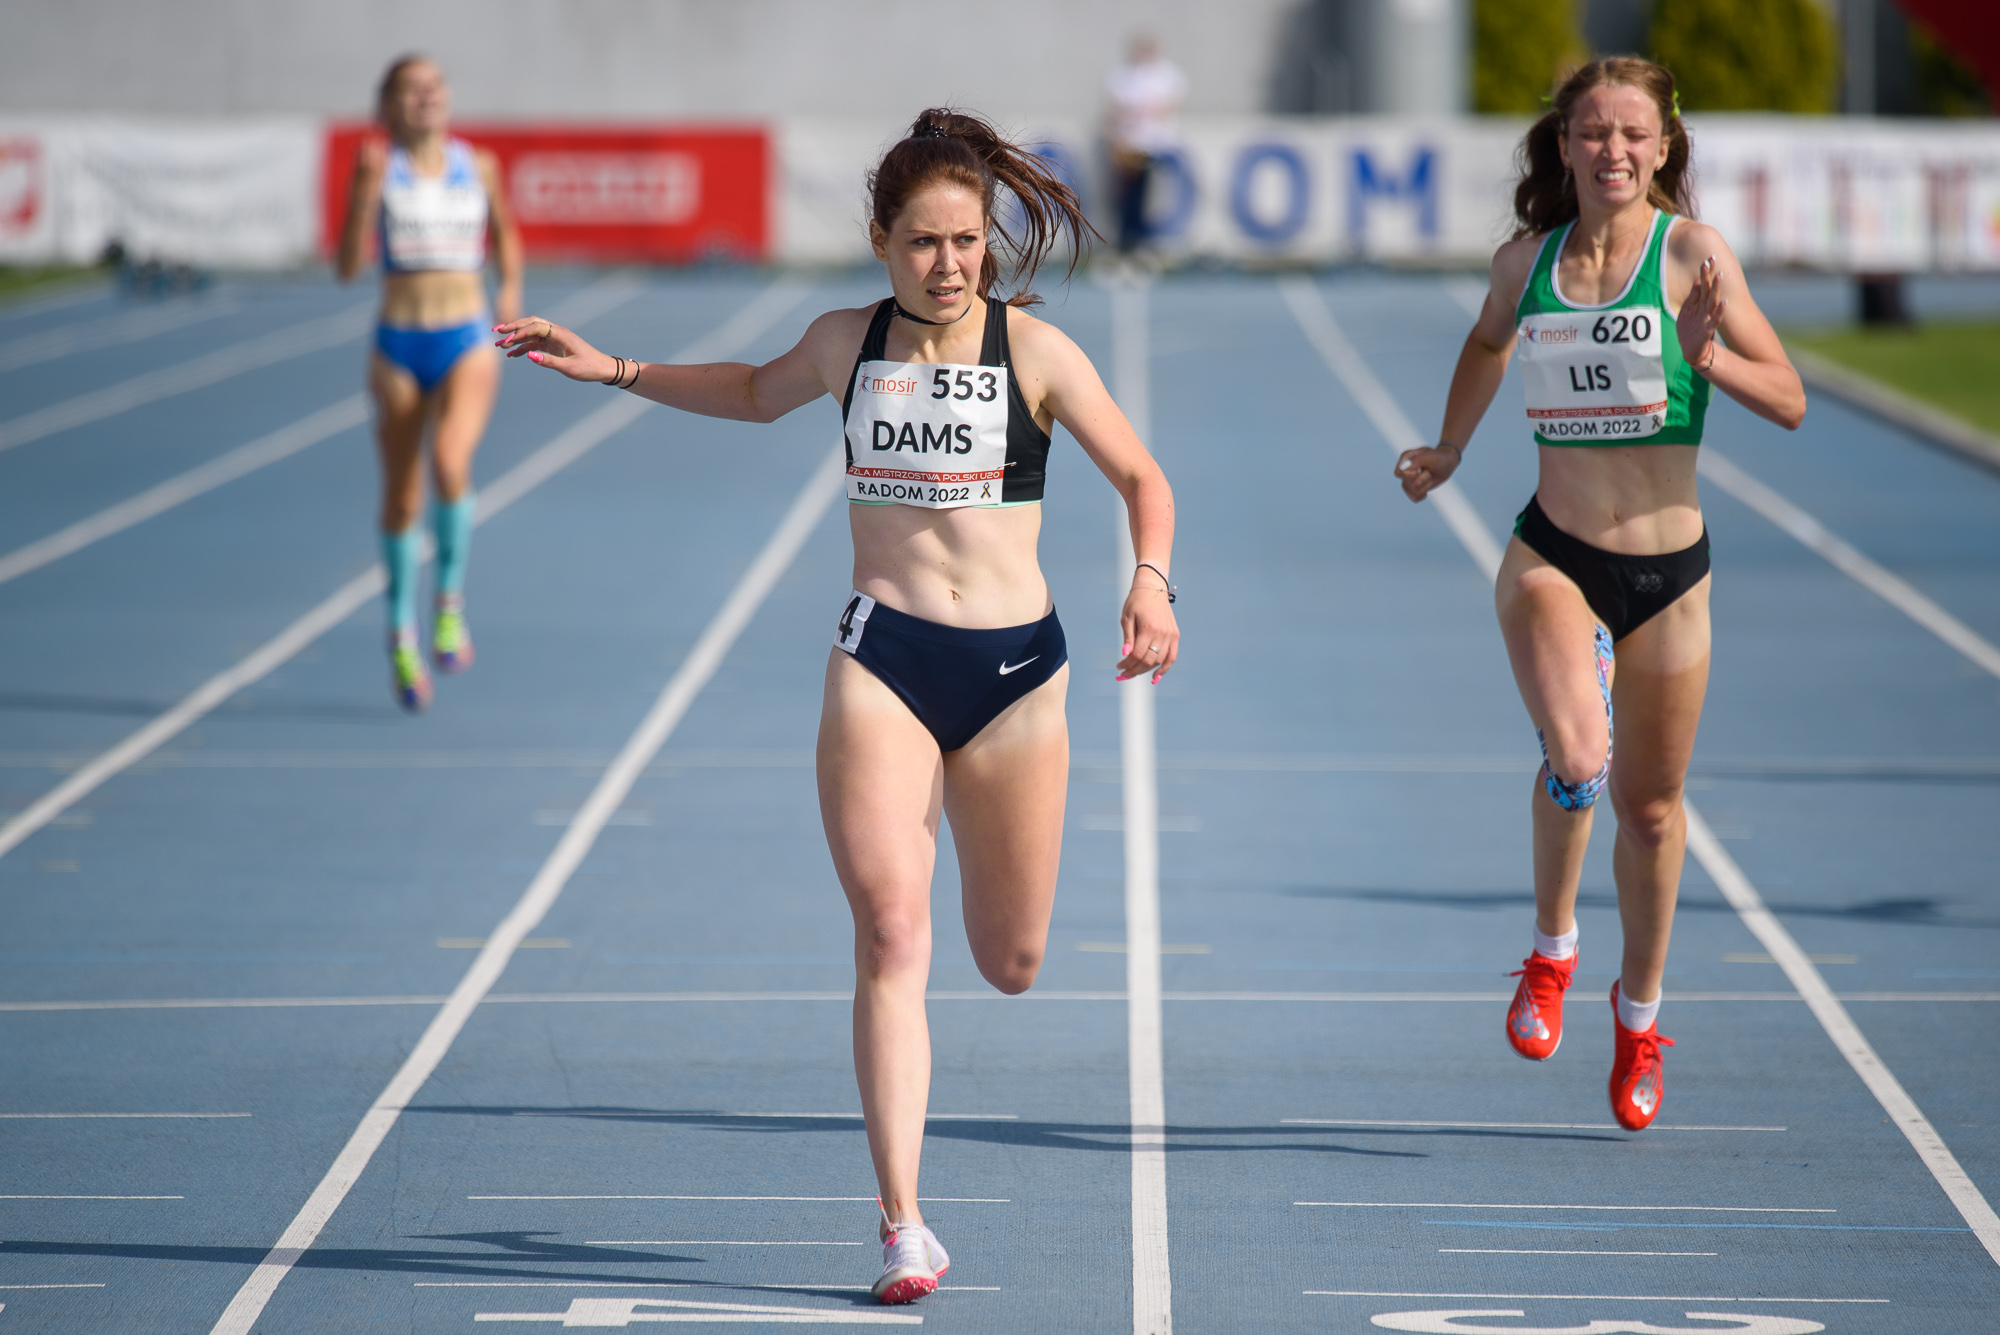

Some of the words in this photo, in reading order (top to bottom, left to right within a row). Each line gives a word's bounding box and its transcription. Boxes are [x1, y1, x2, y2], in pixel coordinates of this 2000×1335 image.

[1540, 324, 1579, 343] mosir
[1592, 314, 1652, 344] 620
[871, 376, 918, 394] mosir
[930, 368, 998, 402] 553
[1569, 364, 1612, 392] LIS
[872, 420, 973, 455] DAMS
[1538, 420, 1599, 437] RADOM
[1602, 418, 1642, 435] 2022
[848, 466, 871, 477] PZLA
[872, 468, 941, 483] MISTRZOSTWA
[942, 472, 978, 482] POLSKI
[979, 470, 1000, 480] U20
[857, 481, 924, 501] RADOM
[927, 486, 970, 503] 2022
[837, 595, 862, 645] 4
